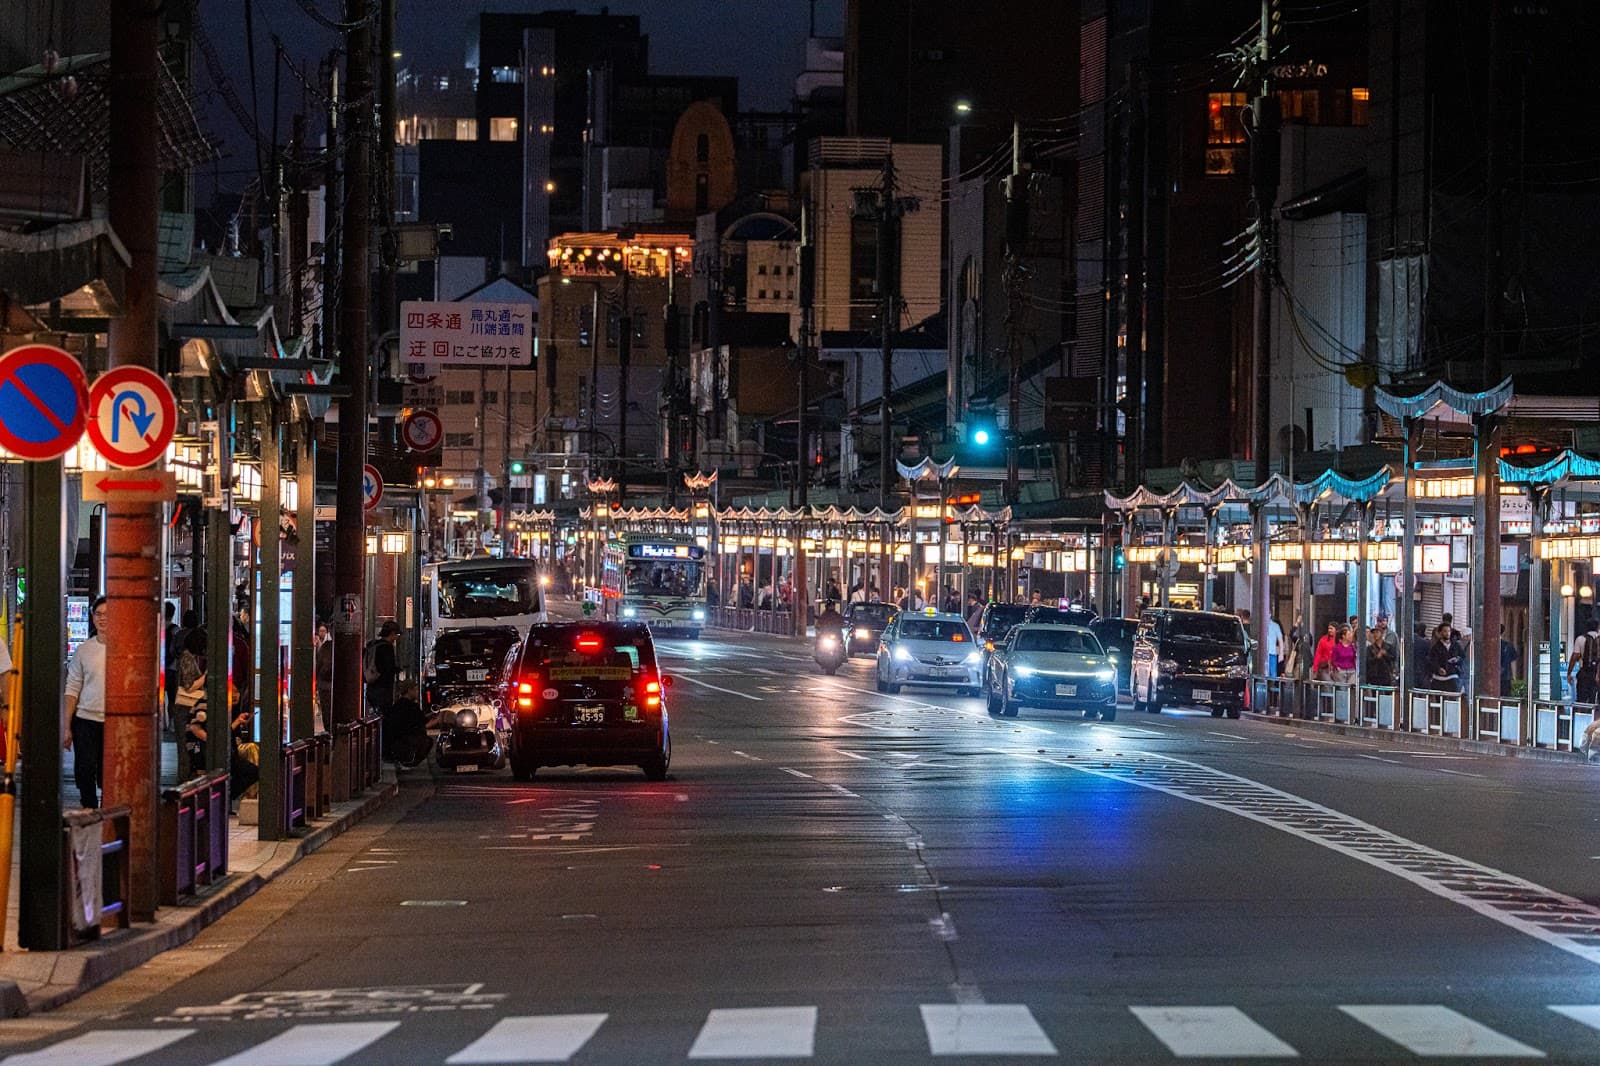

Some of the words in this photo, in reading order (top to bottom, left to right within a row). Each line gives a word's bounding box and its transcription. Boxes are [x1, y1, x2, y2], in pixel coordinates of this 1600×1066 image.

[407, 313, 462, 330] 四条通
[470, 323, 525, 336] 川端通間
[409, 340, 521, 359] 迂回にご協力を
